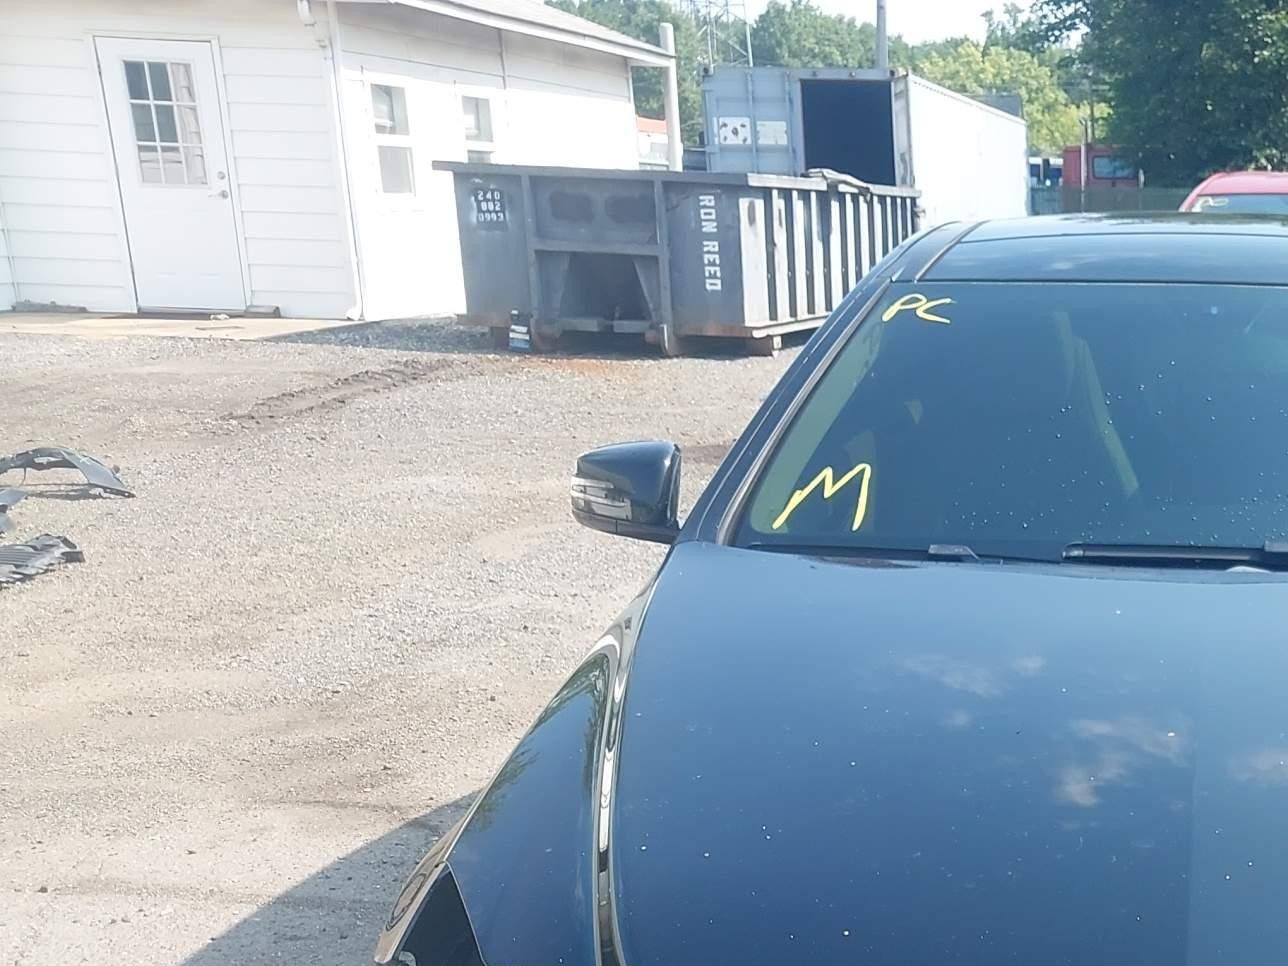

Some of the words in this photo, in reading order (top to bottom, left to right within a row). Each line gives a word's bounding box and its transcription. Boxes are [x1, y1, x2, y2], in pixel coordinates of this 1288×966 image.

[477, 190, 501, 201] 240
[698, 195, 718, 233] RON
[702, 240, 722, 291] REED
[881, 293, 957, 324] PC
[771, 463, 872, 531] M
